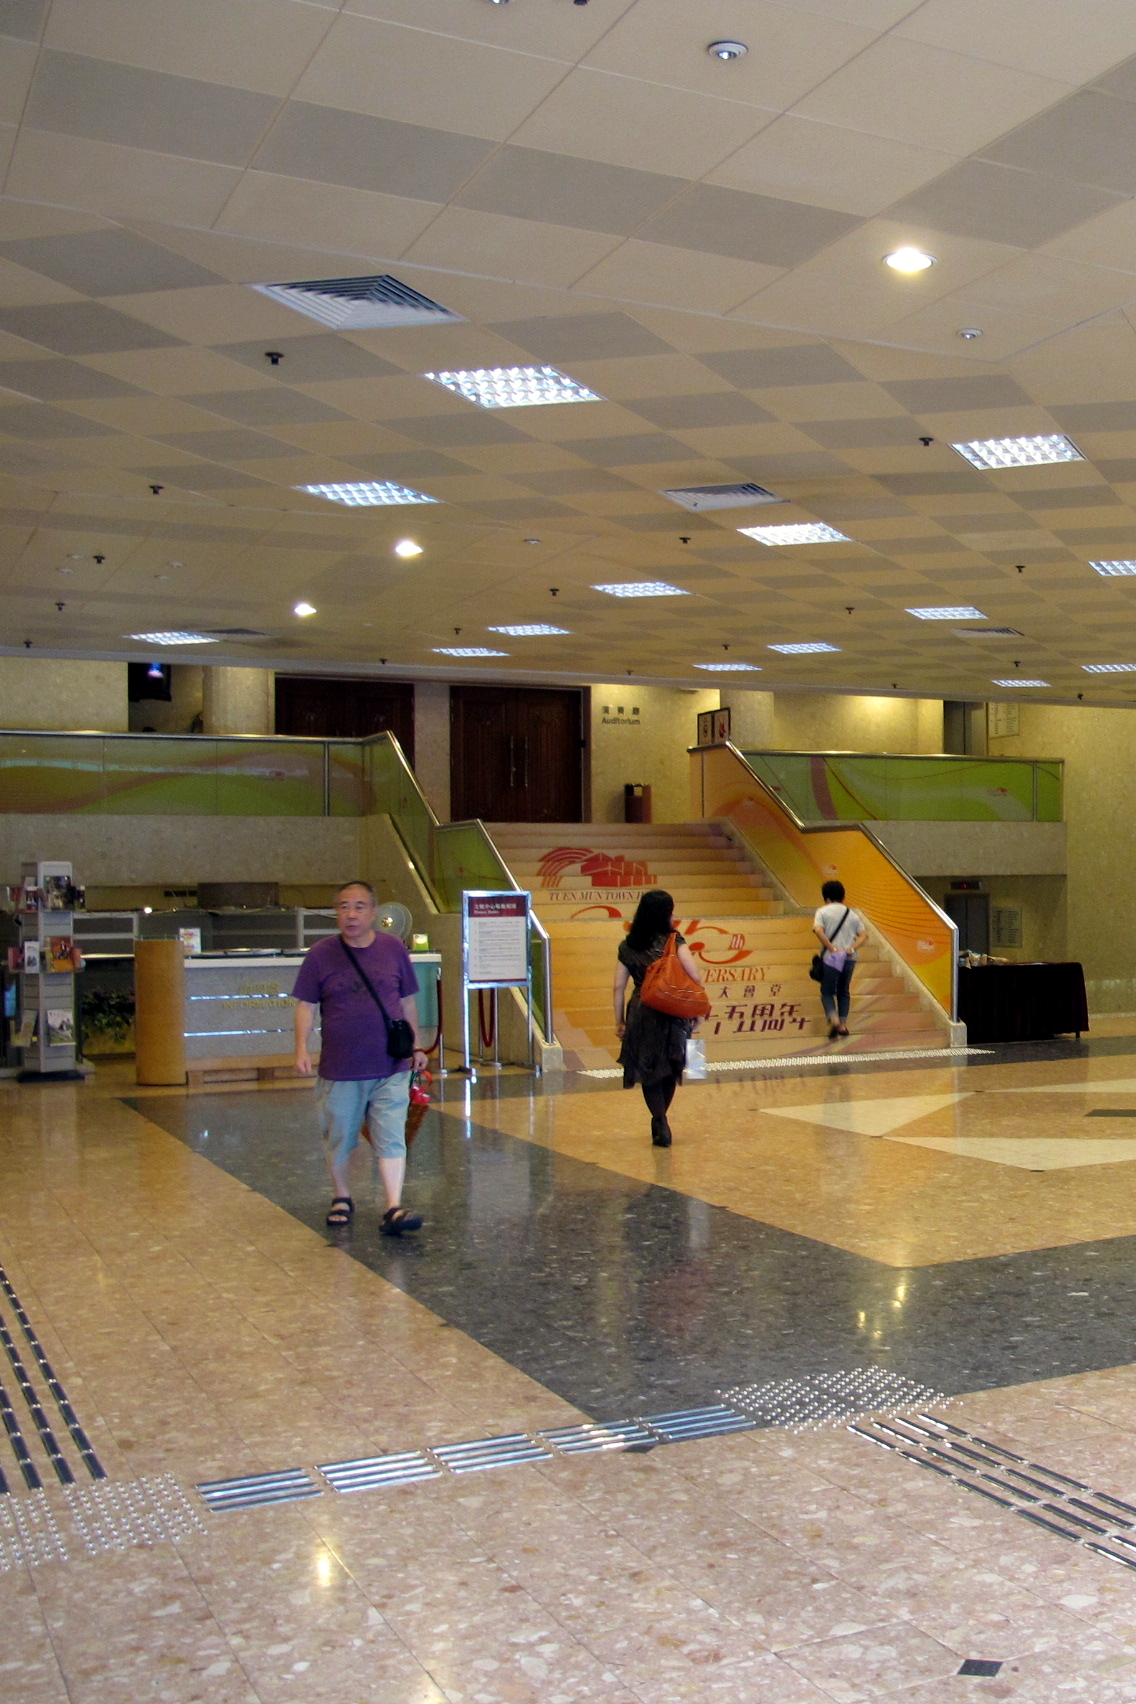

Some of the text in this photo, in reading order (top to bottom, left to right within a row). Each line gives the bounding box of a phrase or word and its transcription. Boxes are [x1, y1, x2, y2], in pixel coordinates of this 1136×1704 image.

[602, 717, 641, 725] Auditorium
[549, 892, 579, 901] TUEN
[580, 892, 604, 900] MUN
[605, 891, 634, 900] TOWN
[705, 967, 768, 983] ERSARY
[719, 984, 782, 998] 大會堂
[692, 1003, 811, 1034] 十五周年
